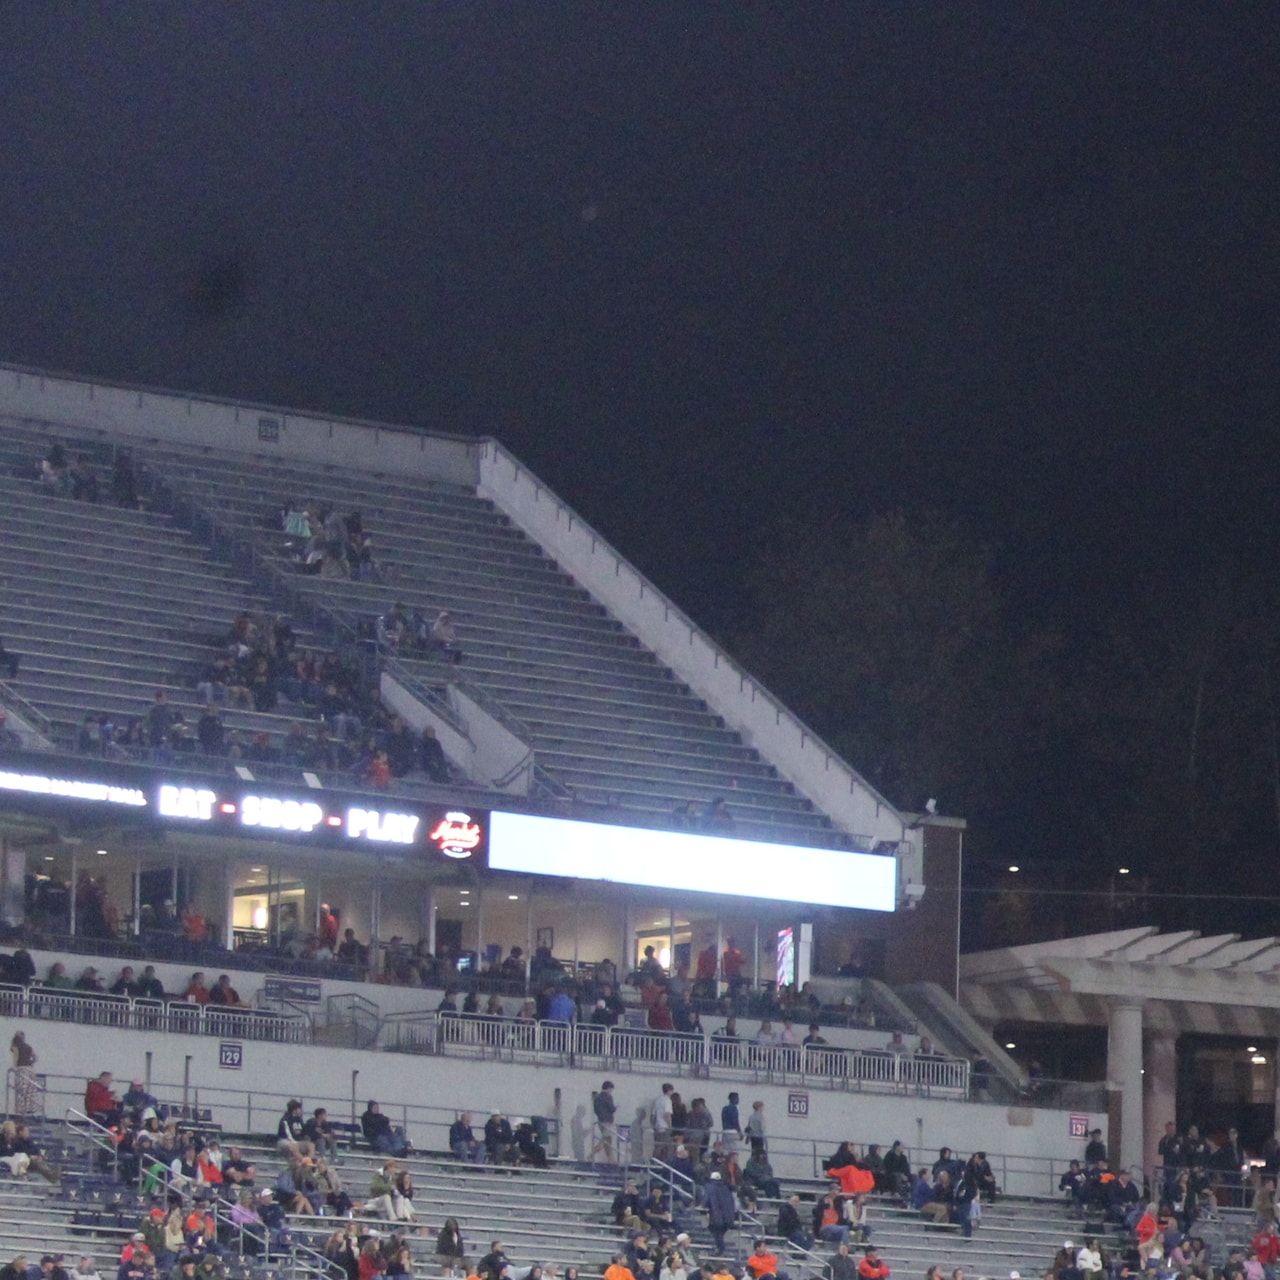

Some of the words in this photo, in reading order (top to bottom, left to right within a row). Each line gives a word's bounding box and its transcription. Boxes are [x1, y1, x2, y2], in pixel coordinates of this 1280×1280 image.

[158, 784, 217, 821] EAT
[240, 795, 323, 832] SHOP
[347, 808, 420, 844] PLAY
[222, 1051, 240, 1064] 129
[790, 1101, 806, 1112] 130
[1072, 1124, 1086, 1135] 131
